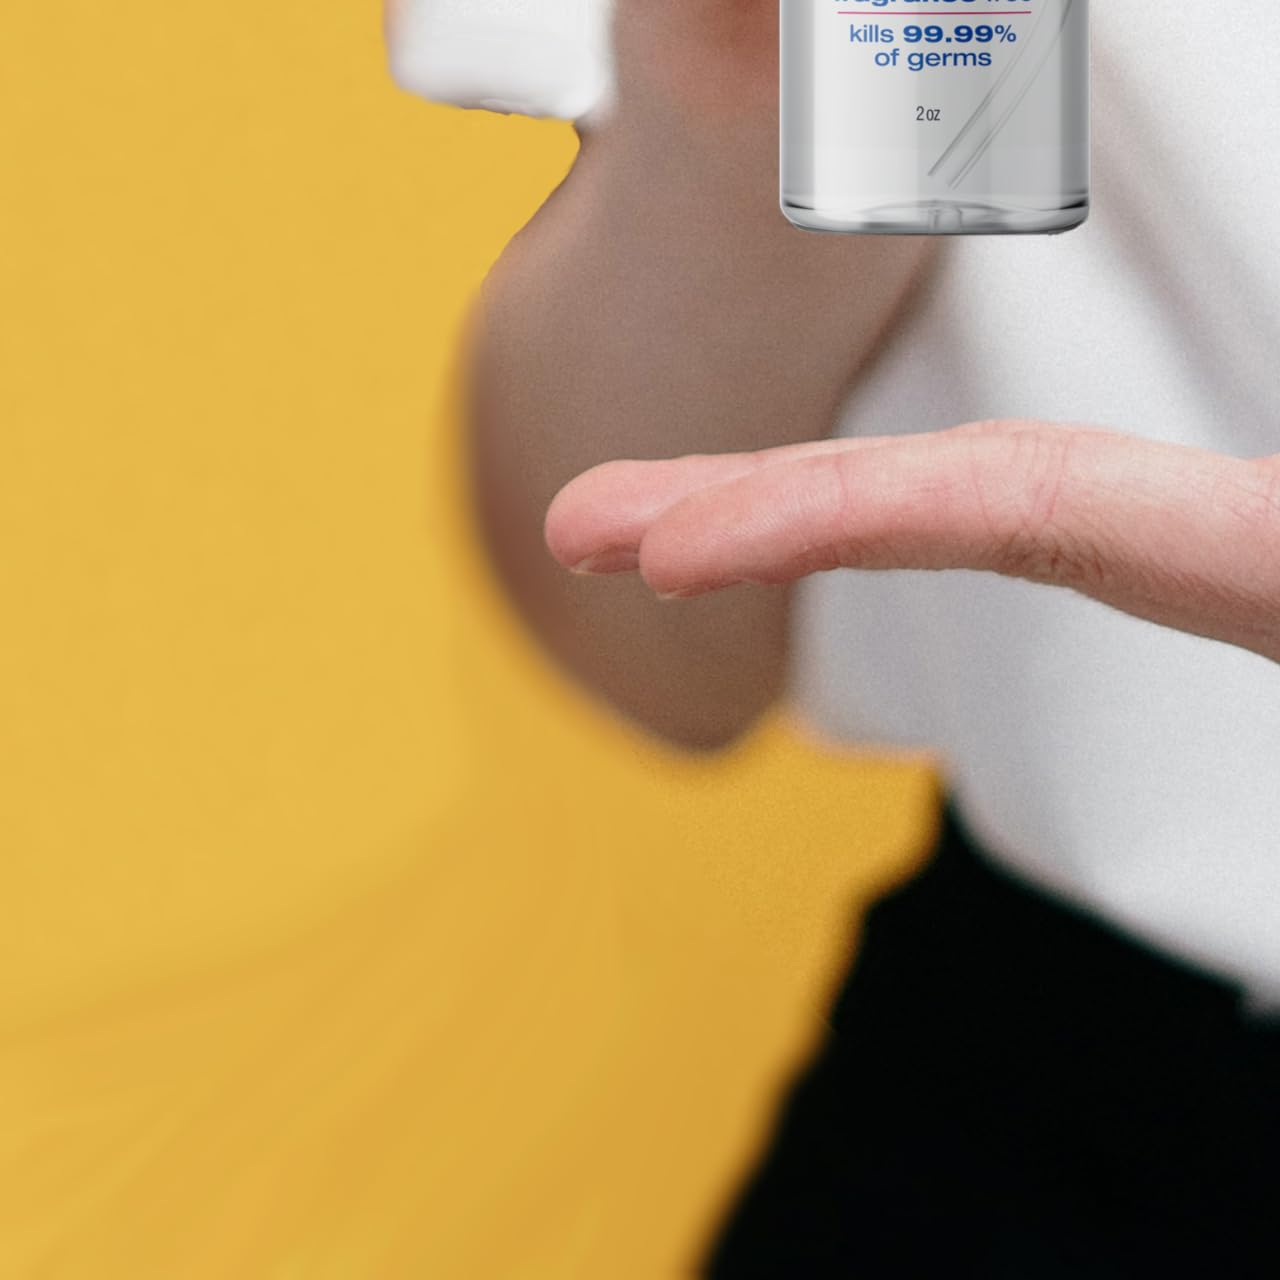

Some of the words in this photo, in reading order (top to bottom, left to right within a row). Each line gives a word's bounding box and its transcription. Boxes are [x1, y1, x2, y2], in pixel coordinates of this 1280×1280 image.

[849, 23, 895, 44] kills
[902, 23, 1018, 44] 99.99%
[874, 48, 901, 67] of
[907, 51, 993, 72] germs
